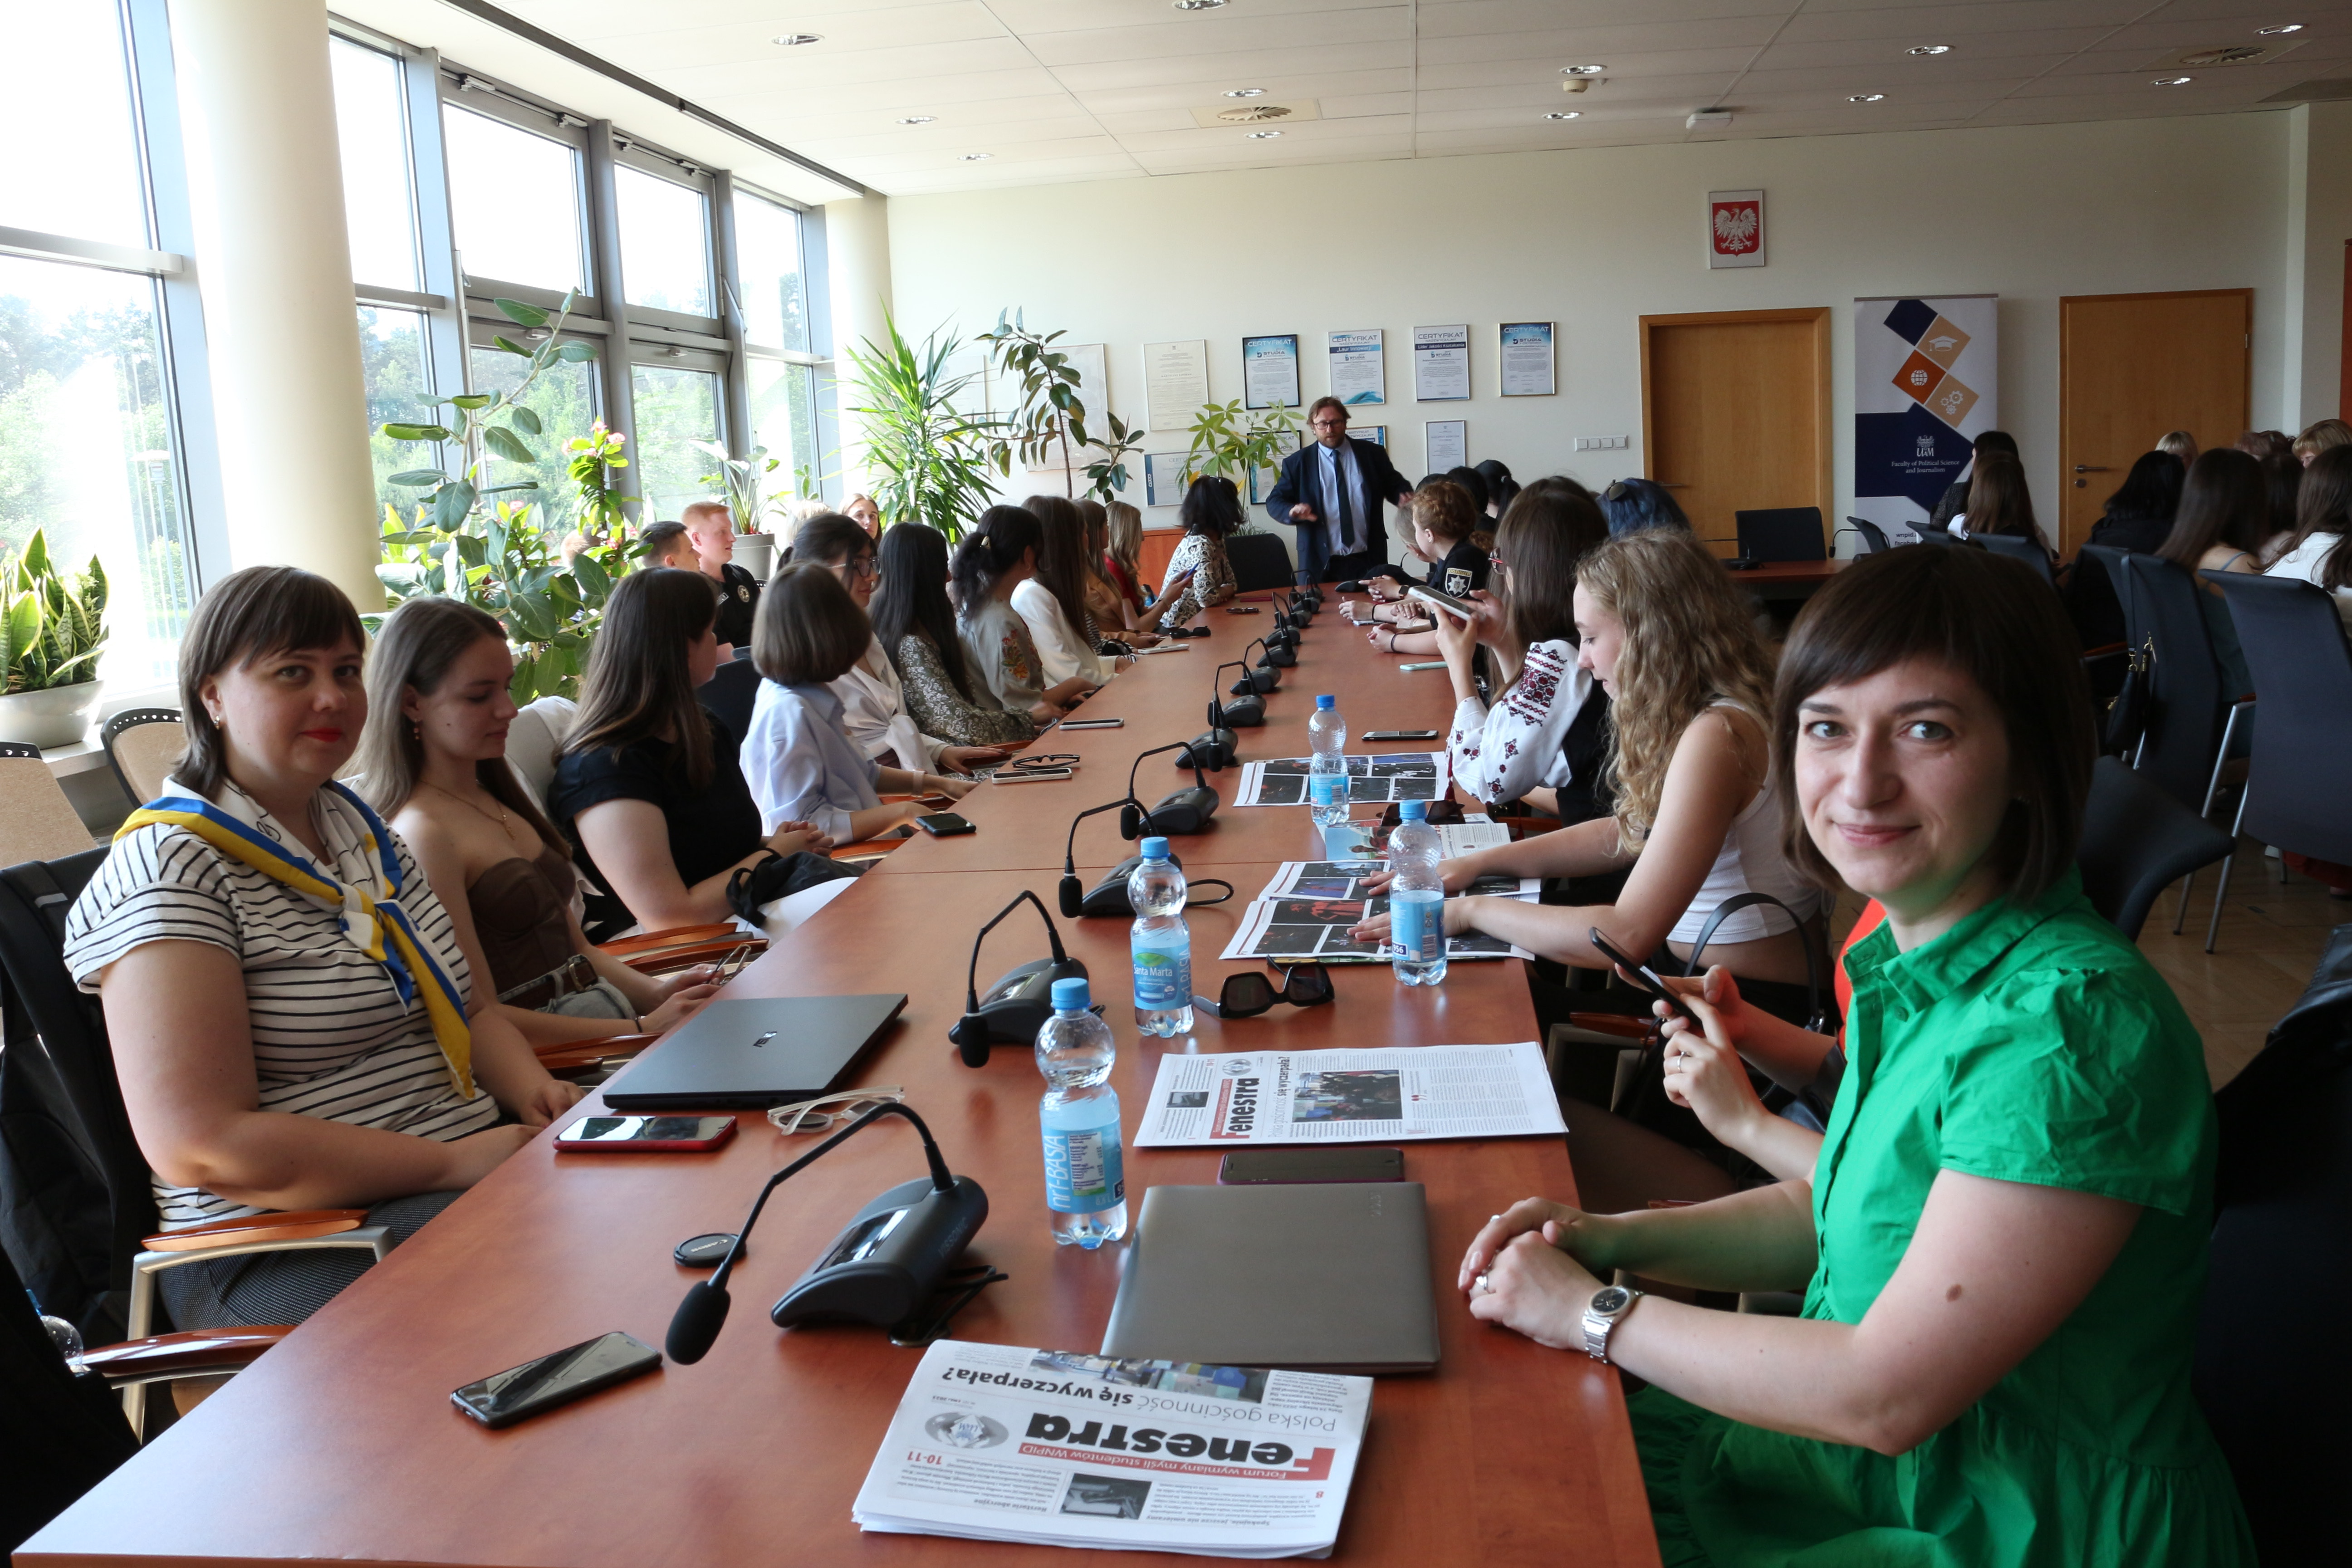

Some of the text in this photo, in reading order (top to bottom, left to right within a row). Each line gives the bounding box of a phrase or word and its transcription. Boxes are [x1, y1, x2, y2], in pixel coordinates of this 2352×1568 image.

[1248, 339, 1292, 347] CERTYFIKAT
[1134, 965, 1172, 977] Santa Marta
[1277, 1056, 1294, 1088] wyczerpała?
[690, 1240, 728, 1252] Canon
[942, 1367, 1335, 1430] Polska gościnność się wyczerpała?
[908, 1452, 944, 1466] 10-11
[1022, 1447, 1288, 1480] Forum wymiany myśli studentów WNPID
[973, 1498, 1010, 1508] aborcyjne
